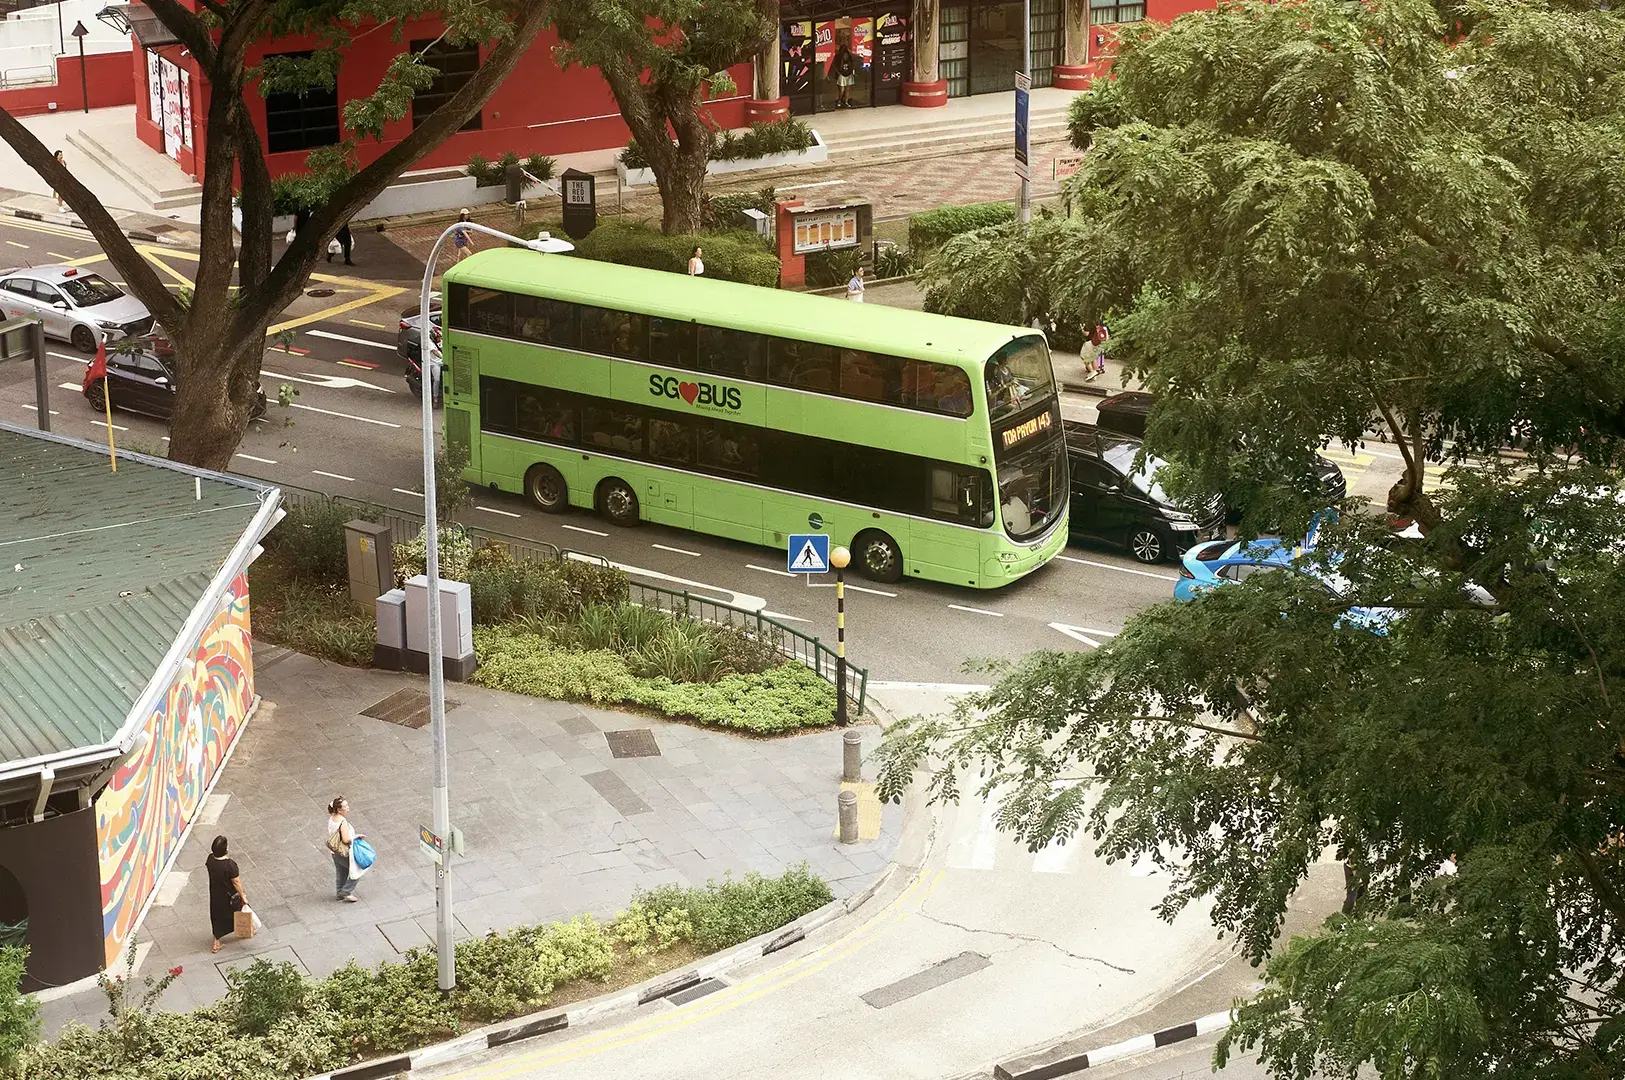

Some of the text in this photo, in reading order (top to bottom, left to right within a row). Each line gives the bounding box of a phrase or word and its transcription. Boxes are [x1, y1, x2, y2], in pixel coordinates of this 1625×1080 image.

[572, 181, 584, 189] THE
[572, 195, 585, 203] BOX
[1037, 411, 1051, 431] 143
